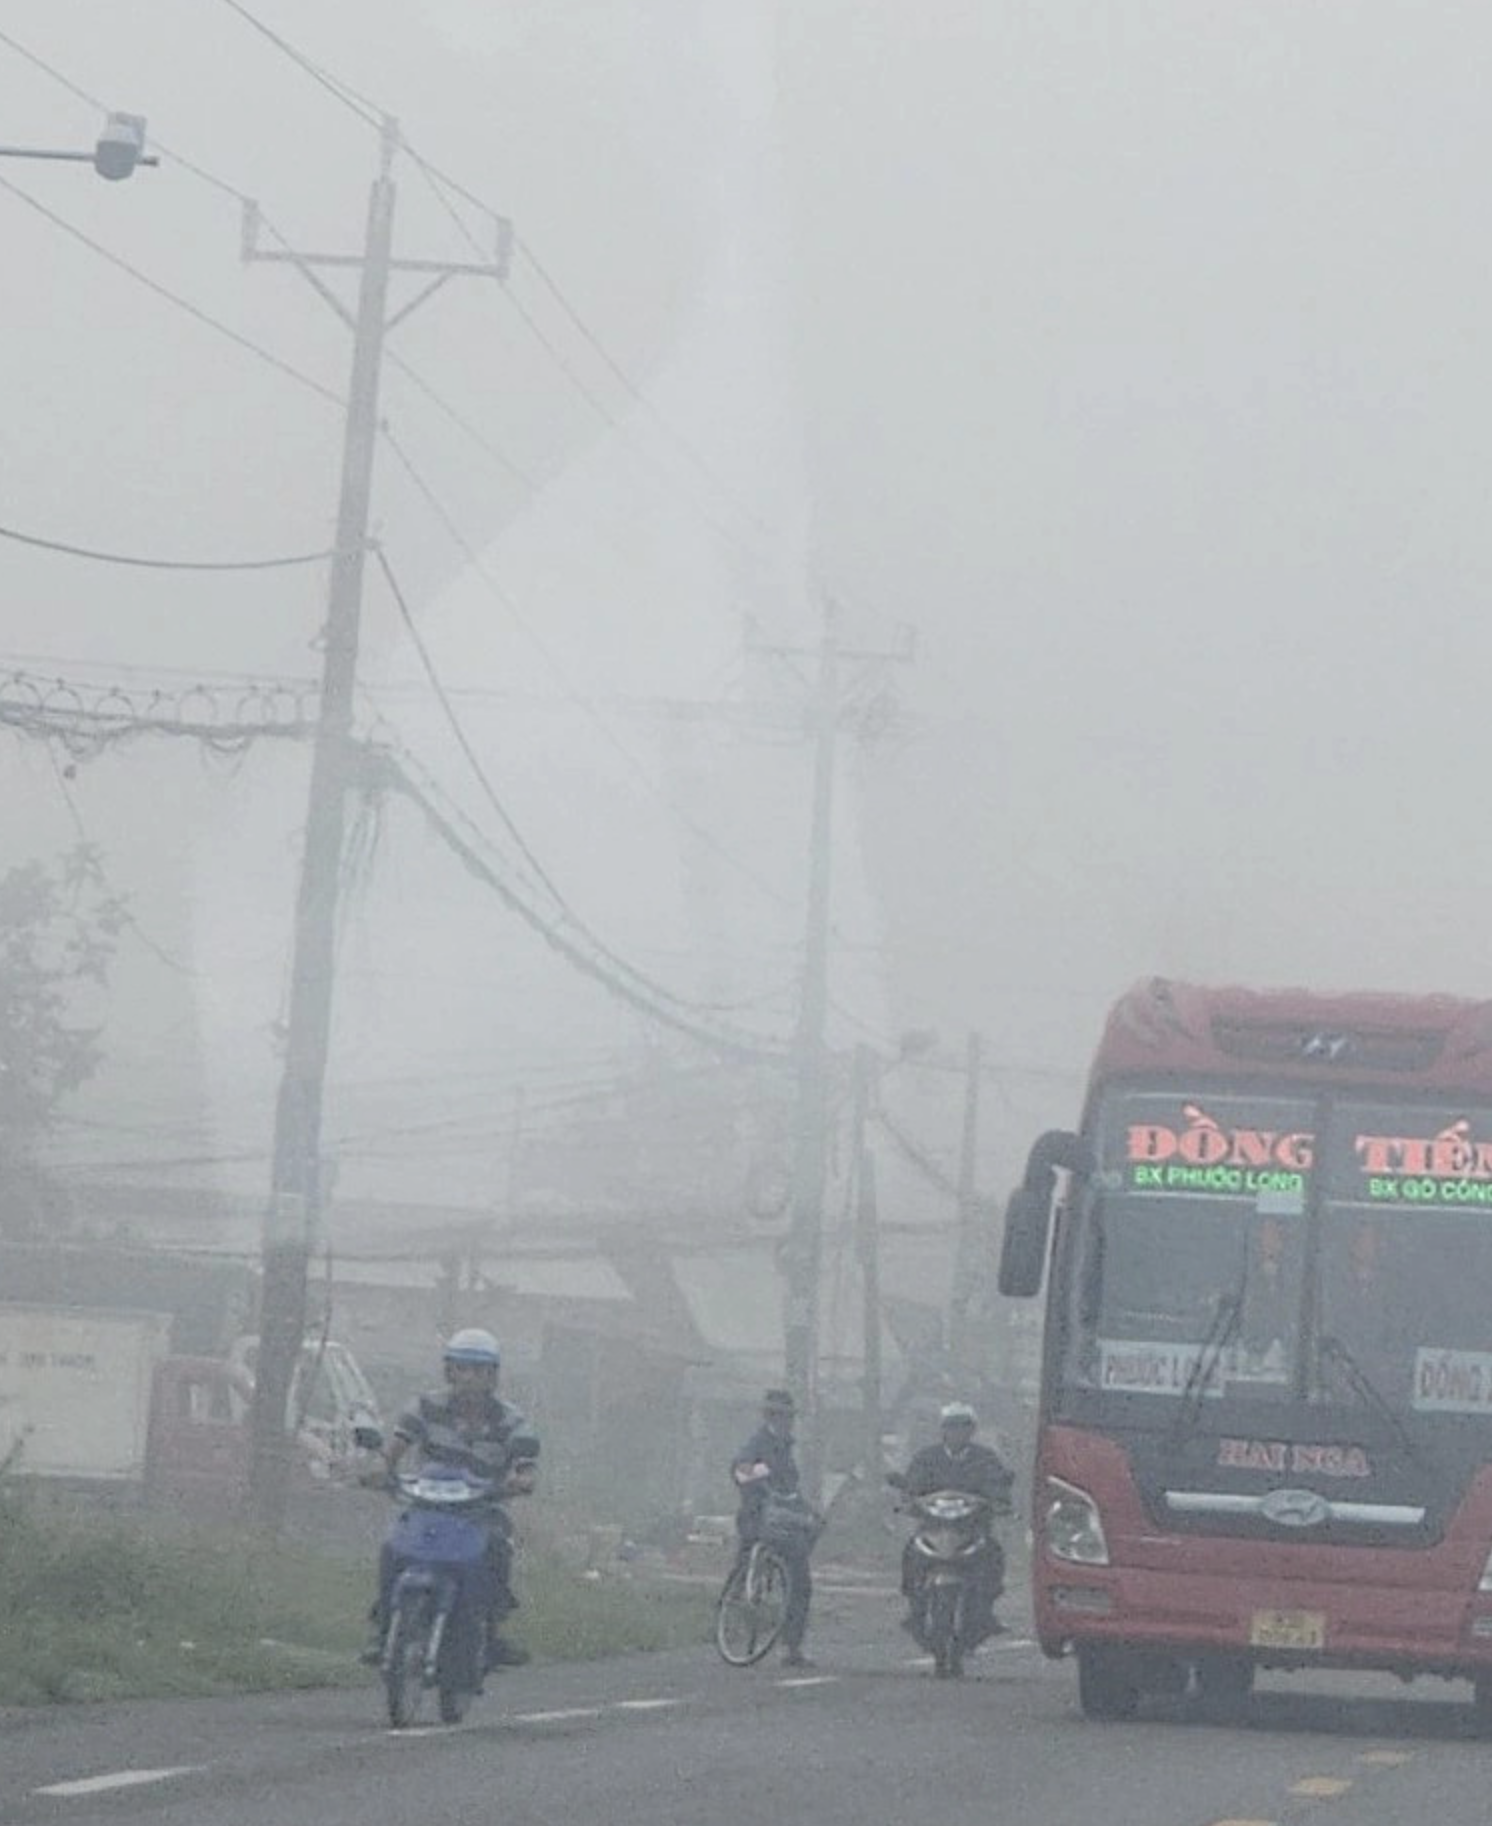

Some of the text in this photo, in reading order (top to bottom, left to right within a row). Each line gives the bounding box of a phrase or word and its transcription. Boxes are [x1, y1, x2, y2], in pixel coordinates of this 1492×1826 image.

[1129, 1104, 1315, 1169] ĐỒNG
[1134, 1166, 1163, 1185] BX
[1246, 1171, 1303, 1191] LONG
[1369, 1178, 1397, 1198] BX
